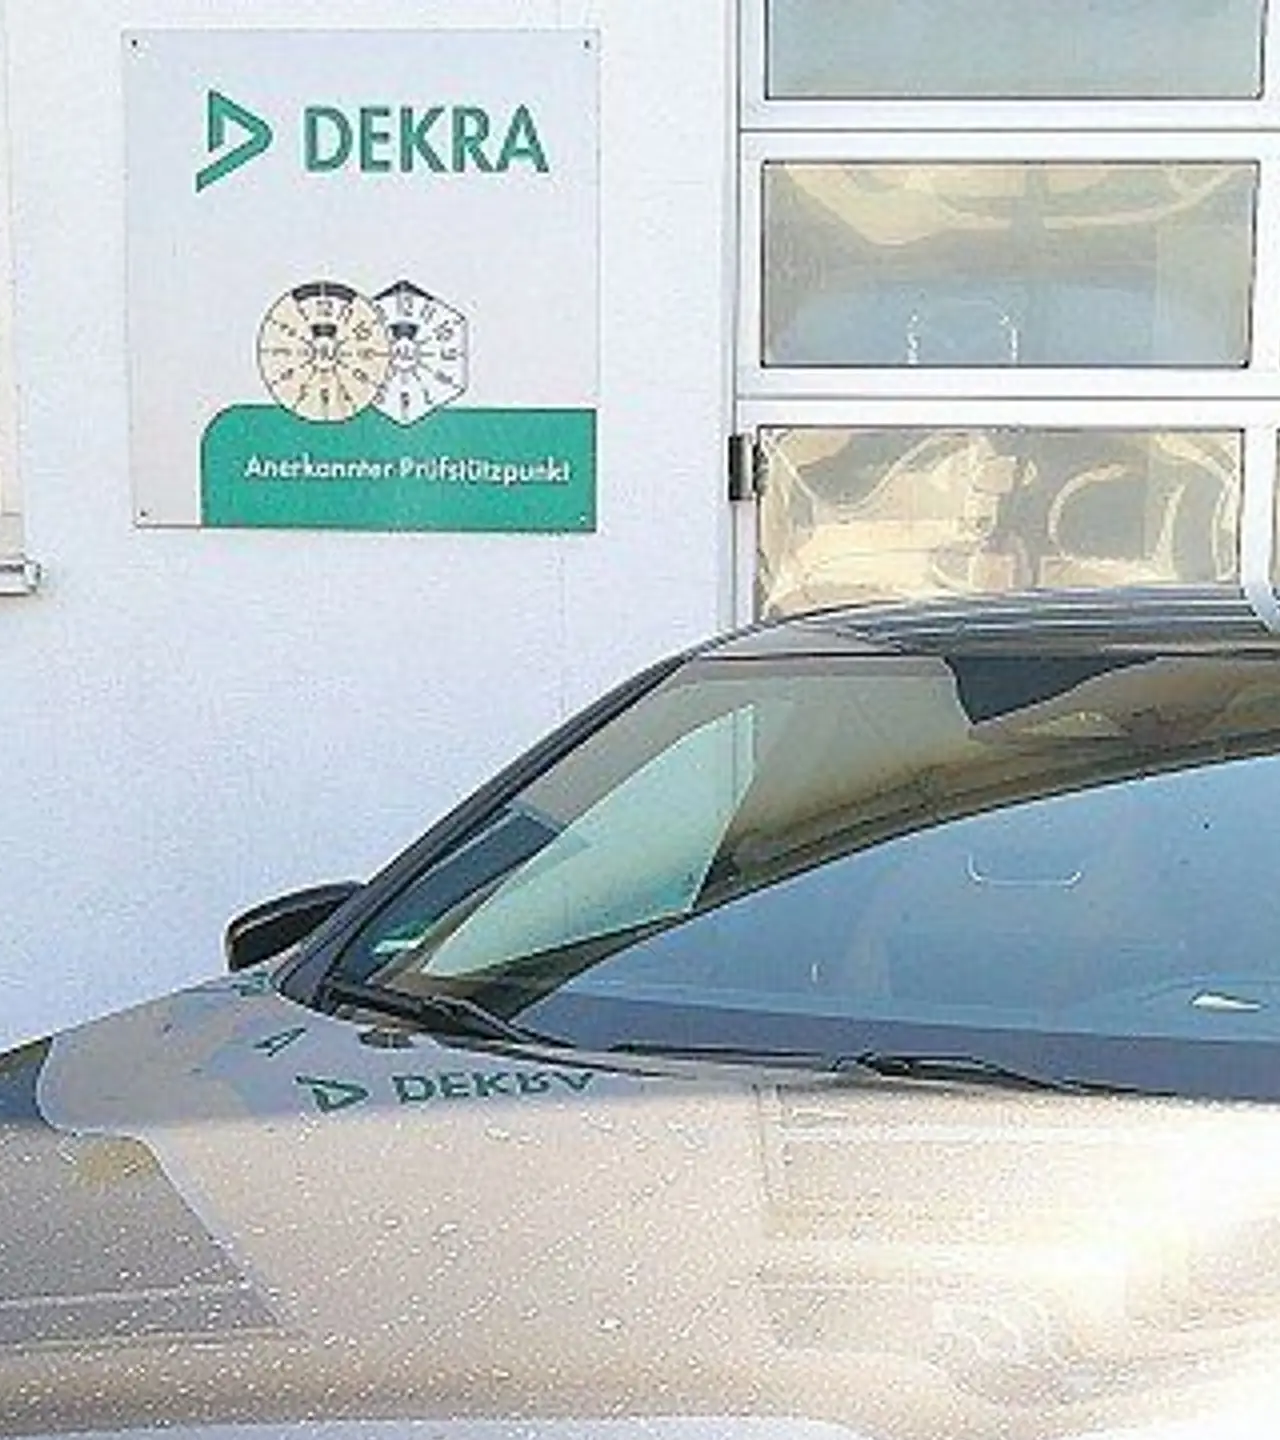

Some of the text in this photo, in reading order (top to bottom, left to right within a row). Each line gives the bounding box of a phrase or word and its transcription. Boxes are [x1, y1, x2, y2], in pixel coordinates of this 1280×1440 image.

[304, 104, 549, 173] DEKRA
[244, 452, 570, 487] Anerkannter Prüfstützpunkt
